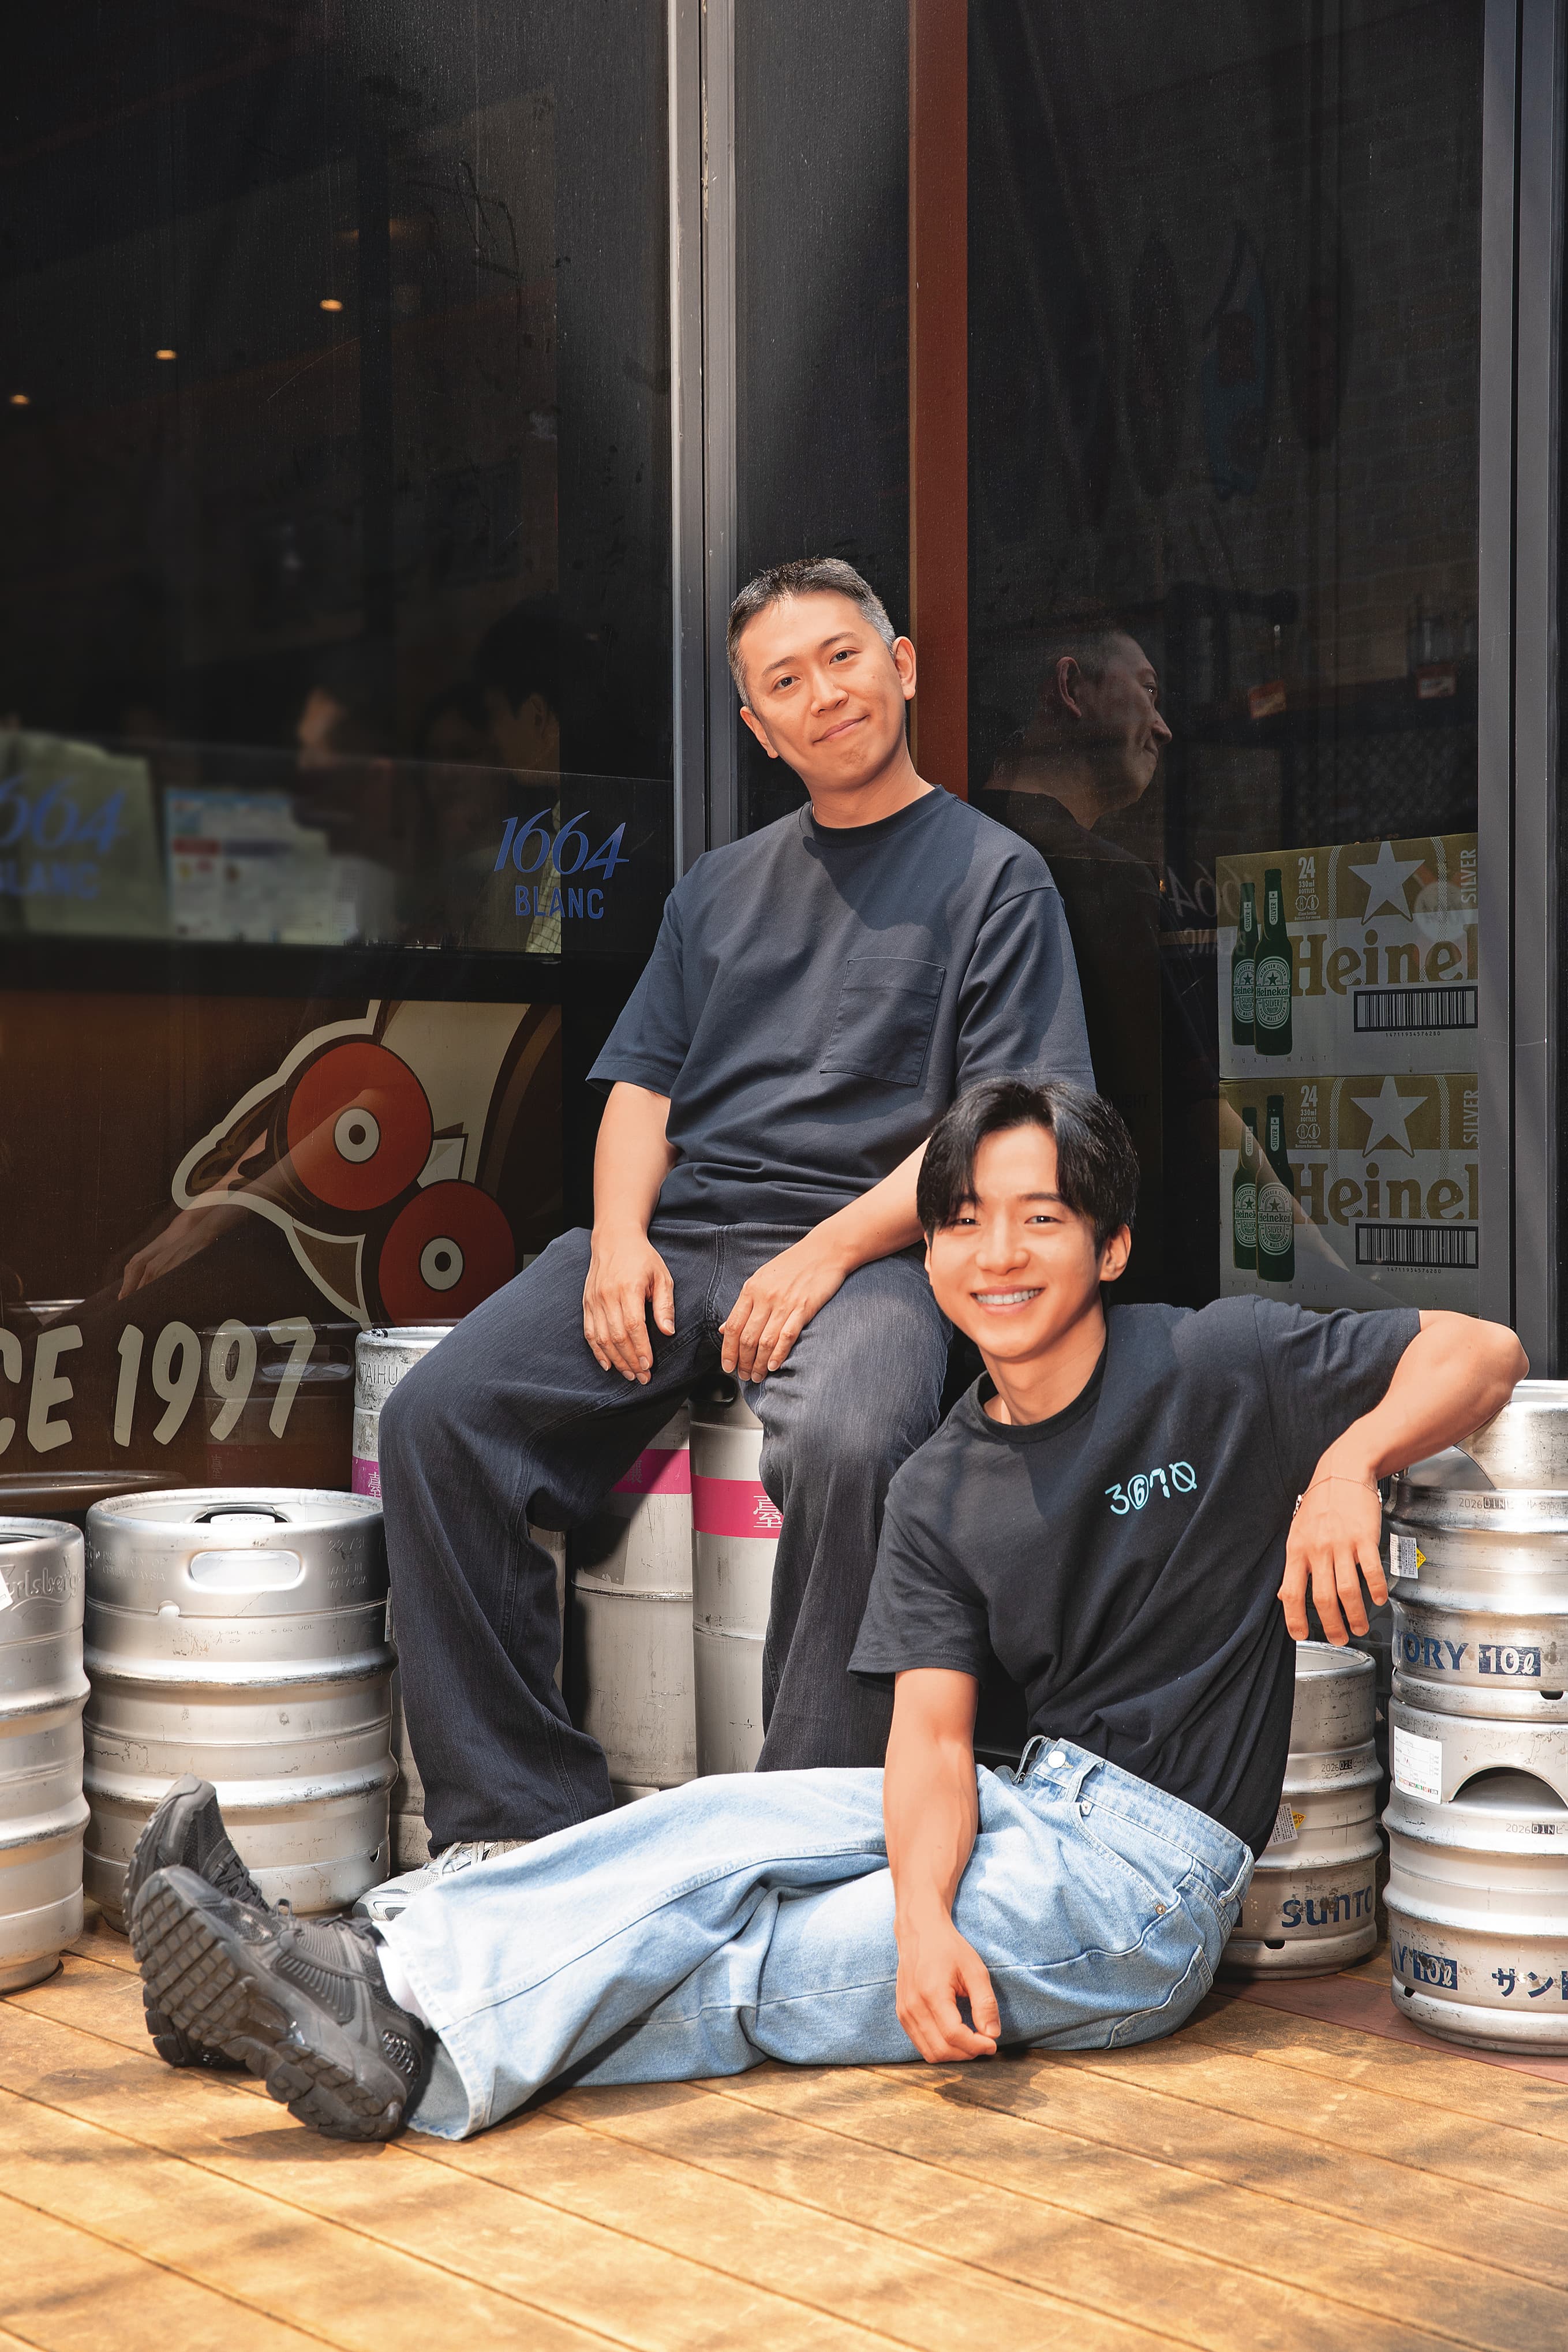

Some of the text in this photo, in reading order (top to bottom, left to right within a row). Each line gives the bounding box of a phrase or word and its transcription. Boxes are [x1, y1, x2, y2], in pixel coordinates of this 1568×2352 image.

[495, 808, 629, 880] 1664
[1298, 856, 1316, 879] 24
[1460, 848, 1477, 904] SILVER
[1298, 880, 1315, 888] 330ml
[515, 886, 604, 919] BLANC
[1256, 986, 1289, 997] Heineken
[1265, 999, 1280, 1007] SILVER
[1301, 1085, 1318, 1107] 24
[1259, 1212, 1292, 1224] Heineken
[1267, 1225, 1282, 1233] SILVER
[114, 1316, 317, 1447] 1997
[361, 1360, 399, 1386] TAIHU
[1105, 1461, 1197, 1515] 3670
